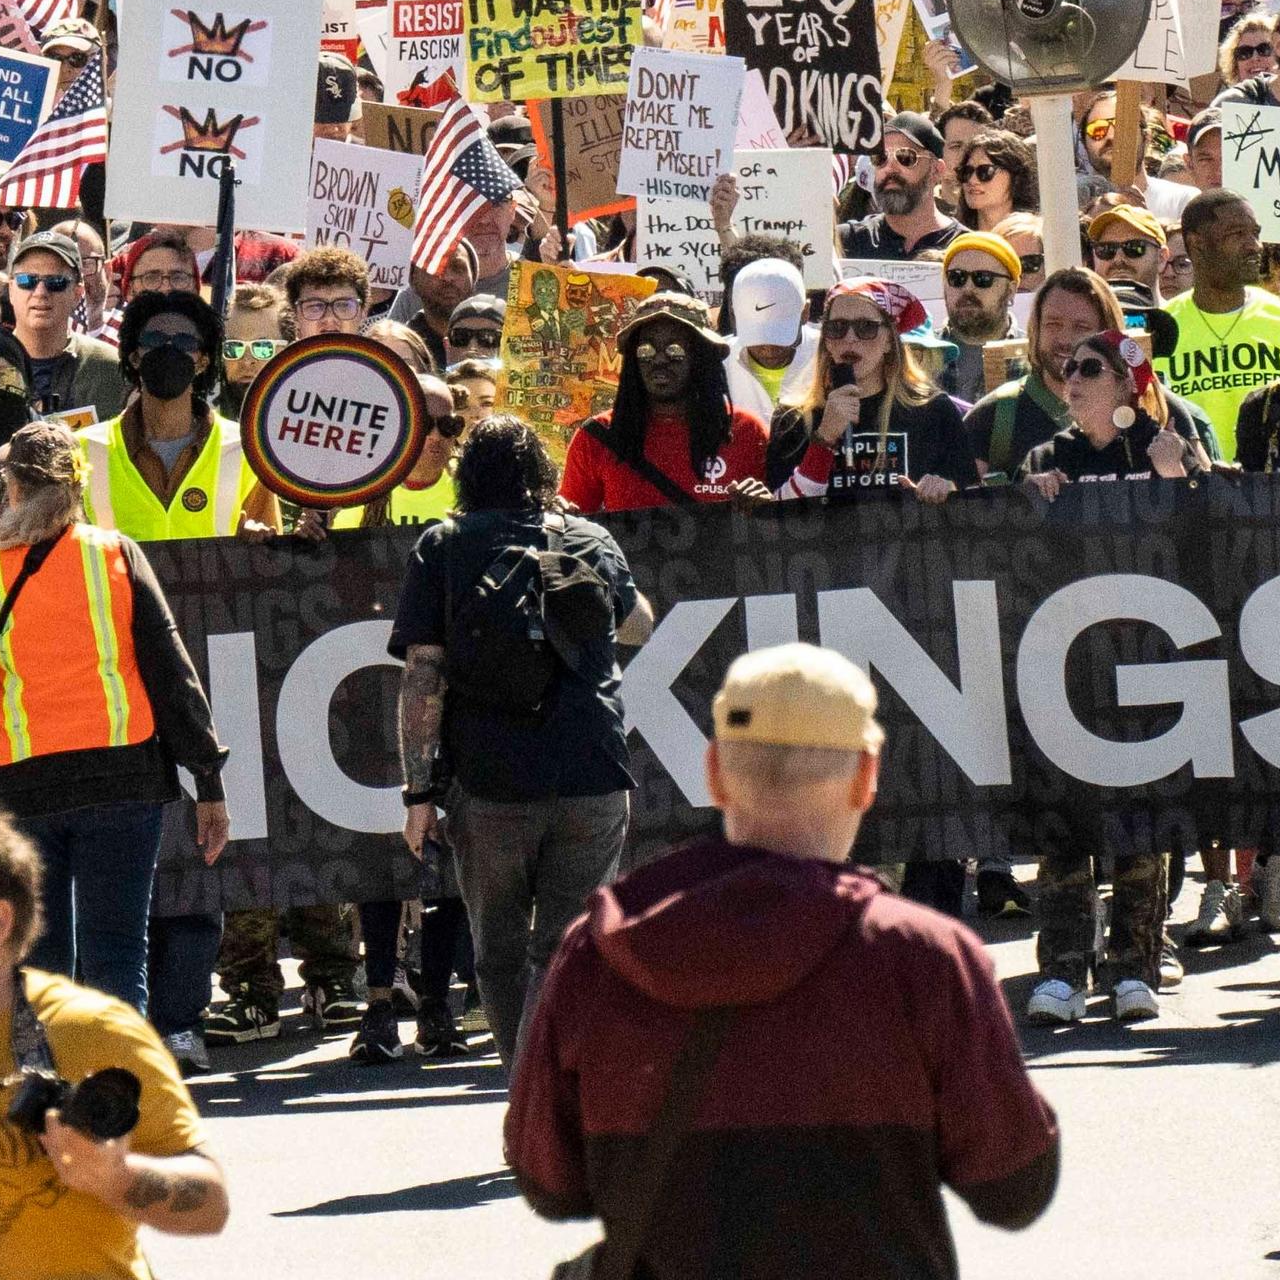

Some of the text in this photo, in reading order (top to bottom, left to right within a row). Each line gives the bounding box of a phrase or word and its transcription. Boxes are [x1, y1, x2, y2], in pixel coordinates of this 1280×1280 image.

[748, 12, 851, 49] YEARS
[398, 38, 460, 63] FASCISM
[792, 45, 820, 63] OF
[188, 56, 242, 83] NO
[625, 125, 681, 152] REPEAT
[313, 159, 381, 208] BROWN
[285, 388, 390, 432] UNITE
[279, 418, 375, 460] HERE!
